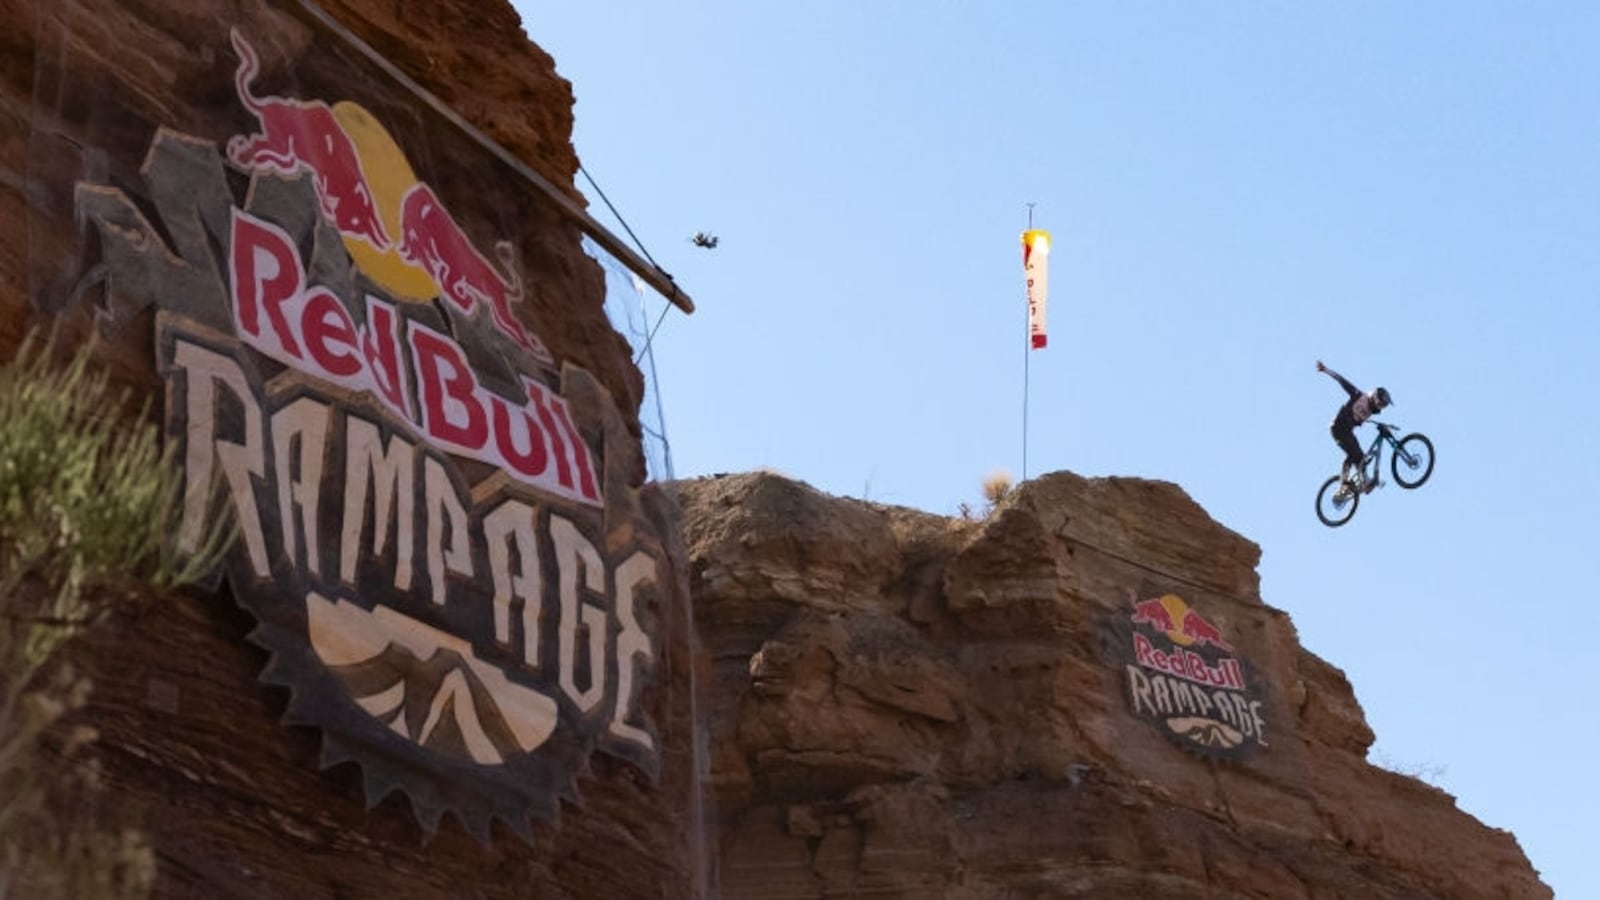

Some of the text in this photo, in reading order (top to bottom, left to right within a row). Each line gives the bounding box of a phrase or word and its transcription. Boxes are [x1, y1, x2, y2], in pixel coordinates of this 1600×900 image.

[234, 219, 598, 498] Red Bull
[174, 340, 656, 749] RAMPAGE
[1127, 665, 1269, 746] RAMPAGE
[1135, 635, 1243, 689] Red Bull
